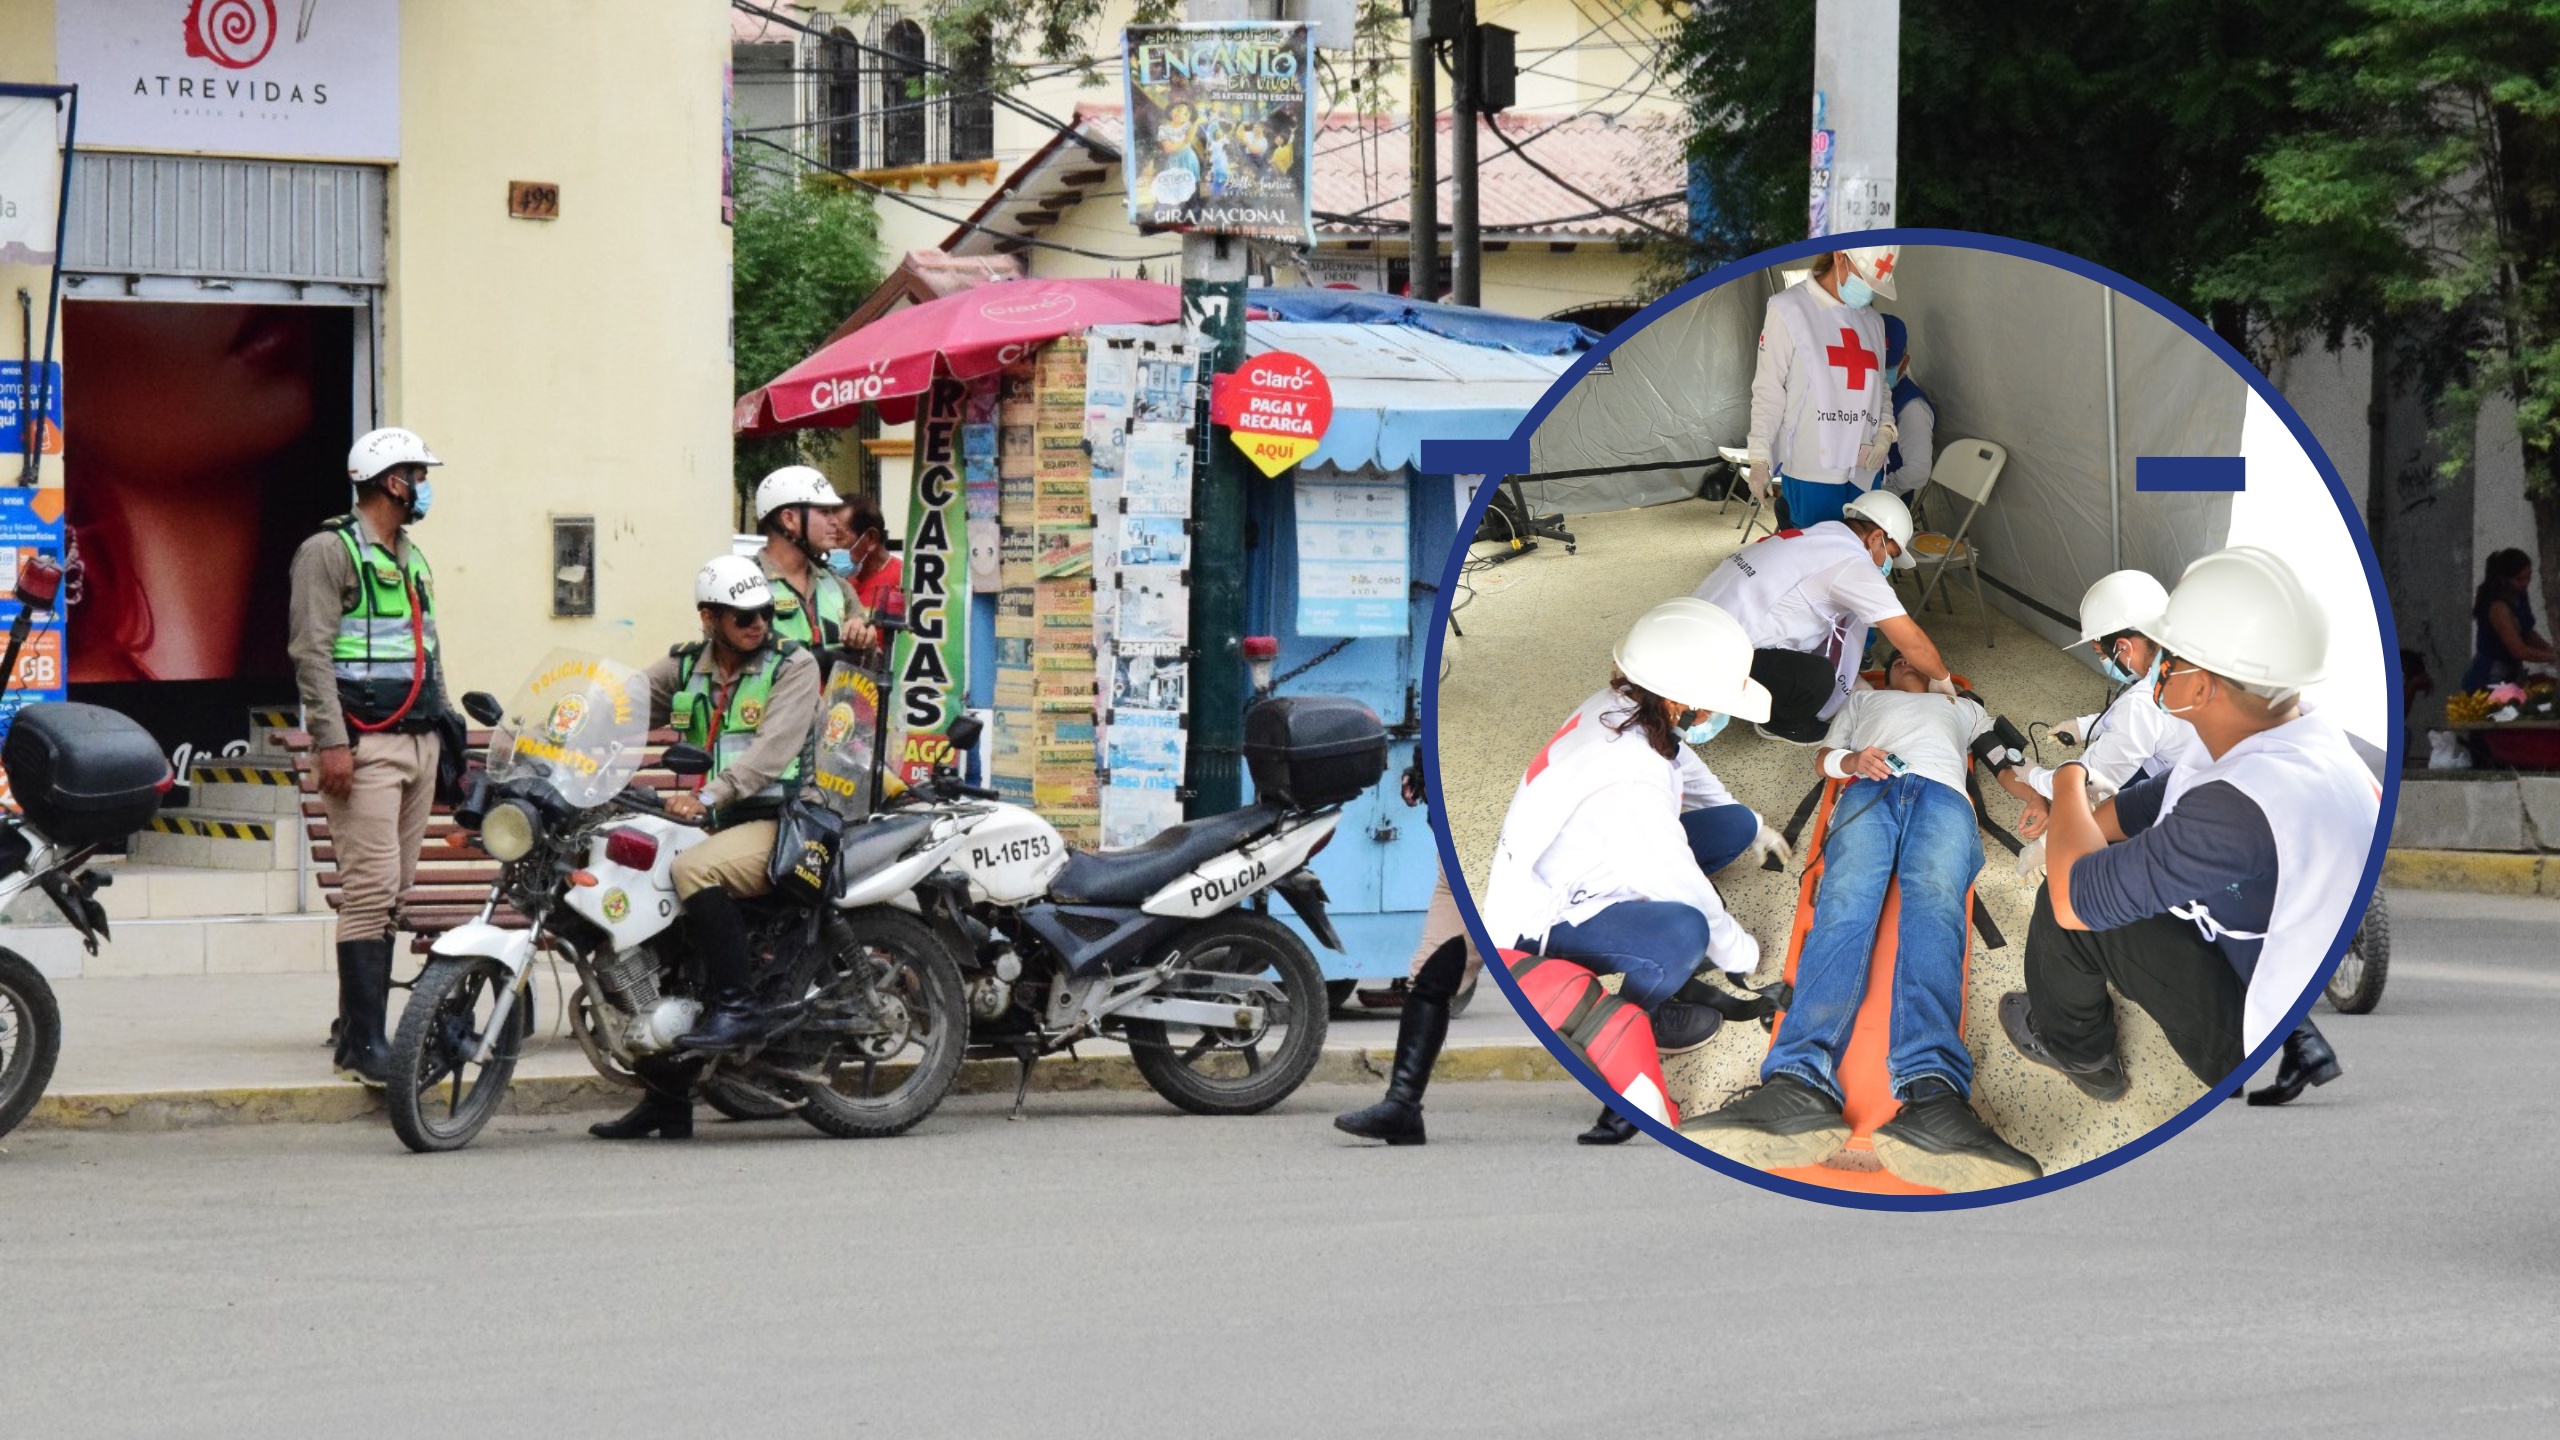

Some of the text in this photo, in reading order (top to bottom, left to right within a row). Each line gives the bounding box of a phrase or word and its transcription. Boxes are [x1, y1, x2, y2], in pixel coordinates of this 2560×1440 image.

[1139, 44, 1297, 85] ENCANTO
[134, 76, 327, 104] ATREVIDAS
[1154, 207, 1289, 225] GIRA NACIONAL
[1324, 271, 1357, 282] DESDE
[811, 366, 890, 411] Claro
[1251, 368, 1306, 390] Claro
[1250, 398, 1307, 417] PAGA Y
[1838, 410, 1859, 424] Roja
[1240, 413, 1313, 435] RECARGA
[1254, 442, 1295, 459] AQUÍ
[903, 378, 964, 727] RECARGAS
[18, 656, 54, 681] GB
[531, 660, 633, 725] POLICIA NACIONAL
[516, 737, 598, 776] TRANSITO
[912, 765, 928, 780] DE
[972, 835, 1051, 870] PL-16753
[1190, 860, 1268, 906] POLICIA
